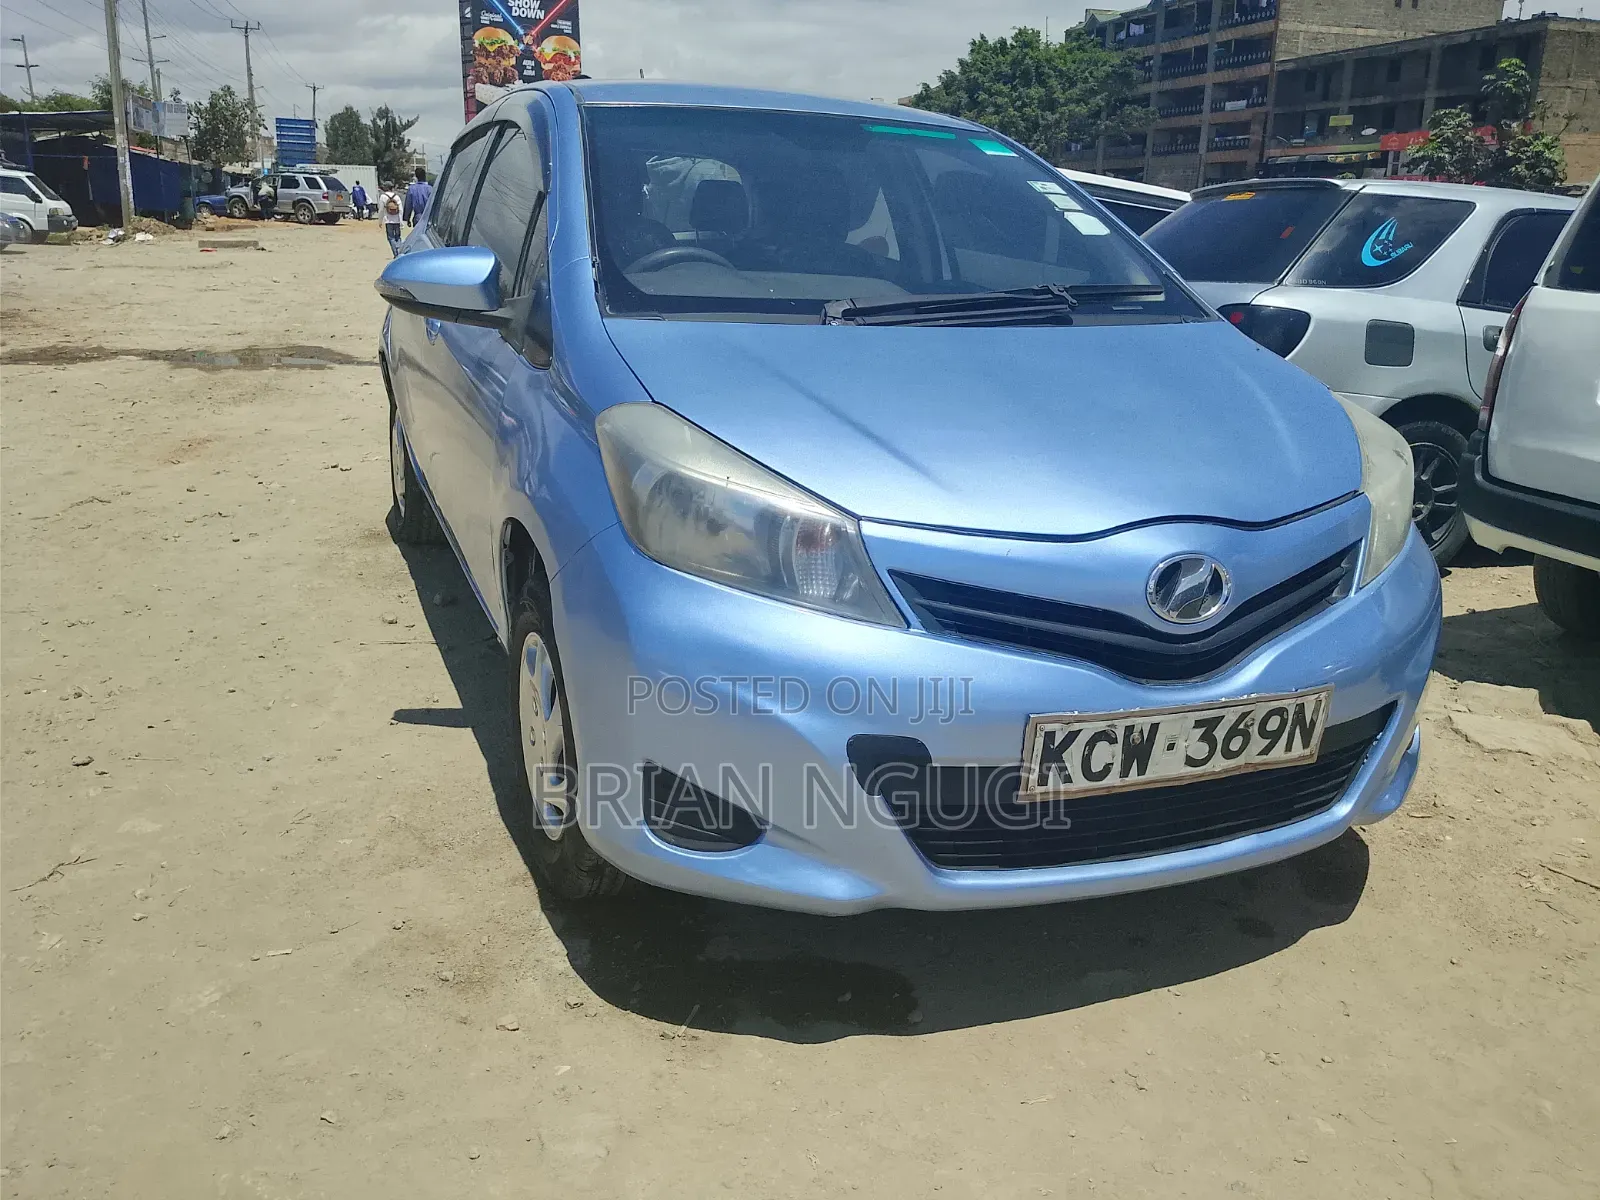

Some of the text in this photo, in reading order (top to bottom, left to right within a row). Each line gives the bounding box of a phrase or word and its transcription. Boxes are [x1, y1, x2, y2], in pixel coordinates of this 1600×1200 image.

[508, 0, 541, 9] SHOW
[511, 7, 545, 20] DOWN
[1390, 241, 1414, 259] SUBARU
[1037, 699, 1323, 787] KCW 369N
